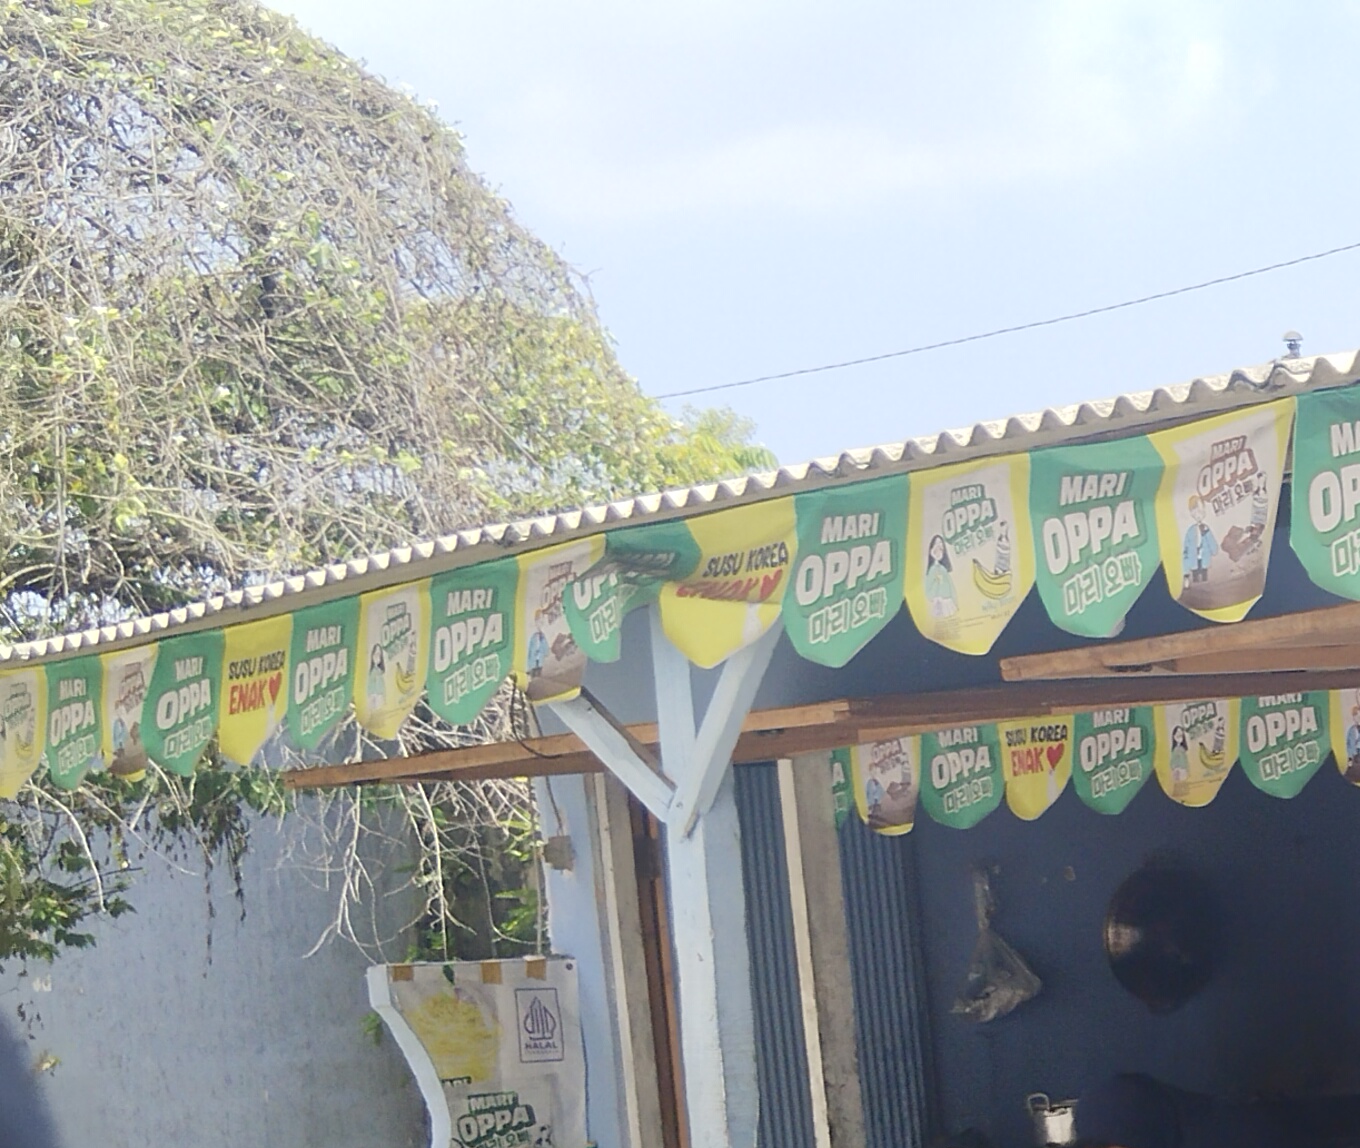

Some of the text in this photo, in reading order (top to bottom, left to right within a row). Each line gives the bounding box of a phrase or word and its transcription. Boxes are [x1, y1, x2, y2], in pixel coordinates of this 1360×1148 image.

[1213, 438, 1245, 458] MARI
[1060, 472, 1127, 505] MARI
[1199, 451, 1254, 495] OPPA
[952, 486, 982, 504] MARI
[821, 512, 880, 545] MARI
[943, 500, 995, 539] OPPA
[1043, 500, 1139, 574] OPPA
[702, 553, 744, 577] SUSU
[747, 542, 788, 572] KOREA
[795, 540, 891, 605] OPPA
[447, 589, 493, 617] MARI
[1063, 564, 1102, 615] 마리
[307, 626, 342, 652] MARI
[434, 613, 503, 672] OPPA
[229, 657, 257, 680] SUSU
[296, 649, 348, 704] OPPA
[157, 678, 211, 729] OPPA
[229, 679, 267, 715] ENAK
[51, 701, 95, 746] OPPA
[1030, 724, 1068, 742] KOREA
[1094, 709, 1129, 728] MARI
[1247, 707, 1317, 753] OPPA
[938, 728, 978, 747] MARI
[1080, 727, 1142, 772] OPPA
[932, 747, 991, 789] OPPA
[1011, 747, 1044, 776] ENAK
[524, 1041, 558, 1049] HALAL
[460, 1106, 531, 1145] OPPA
